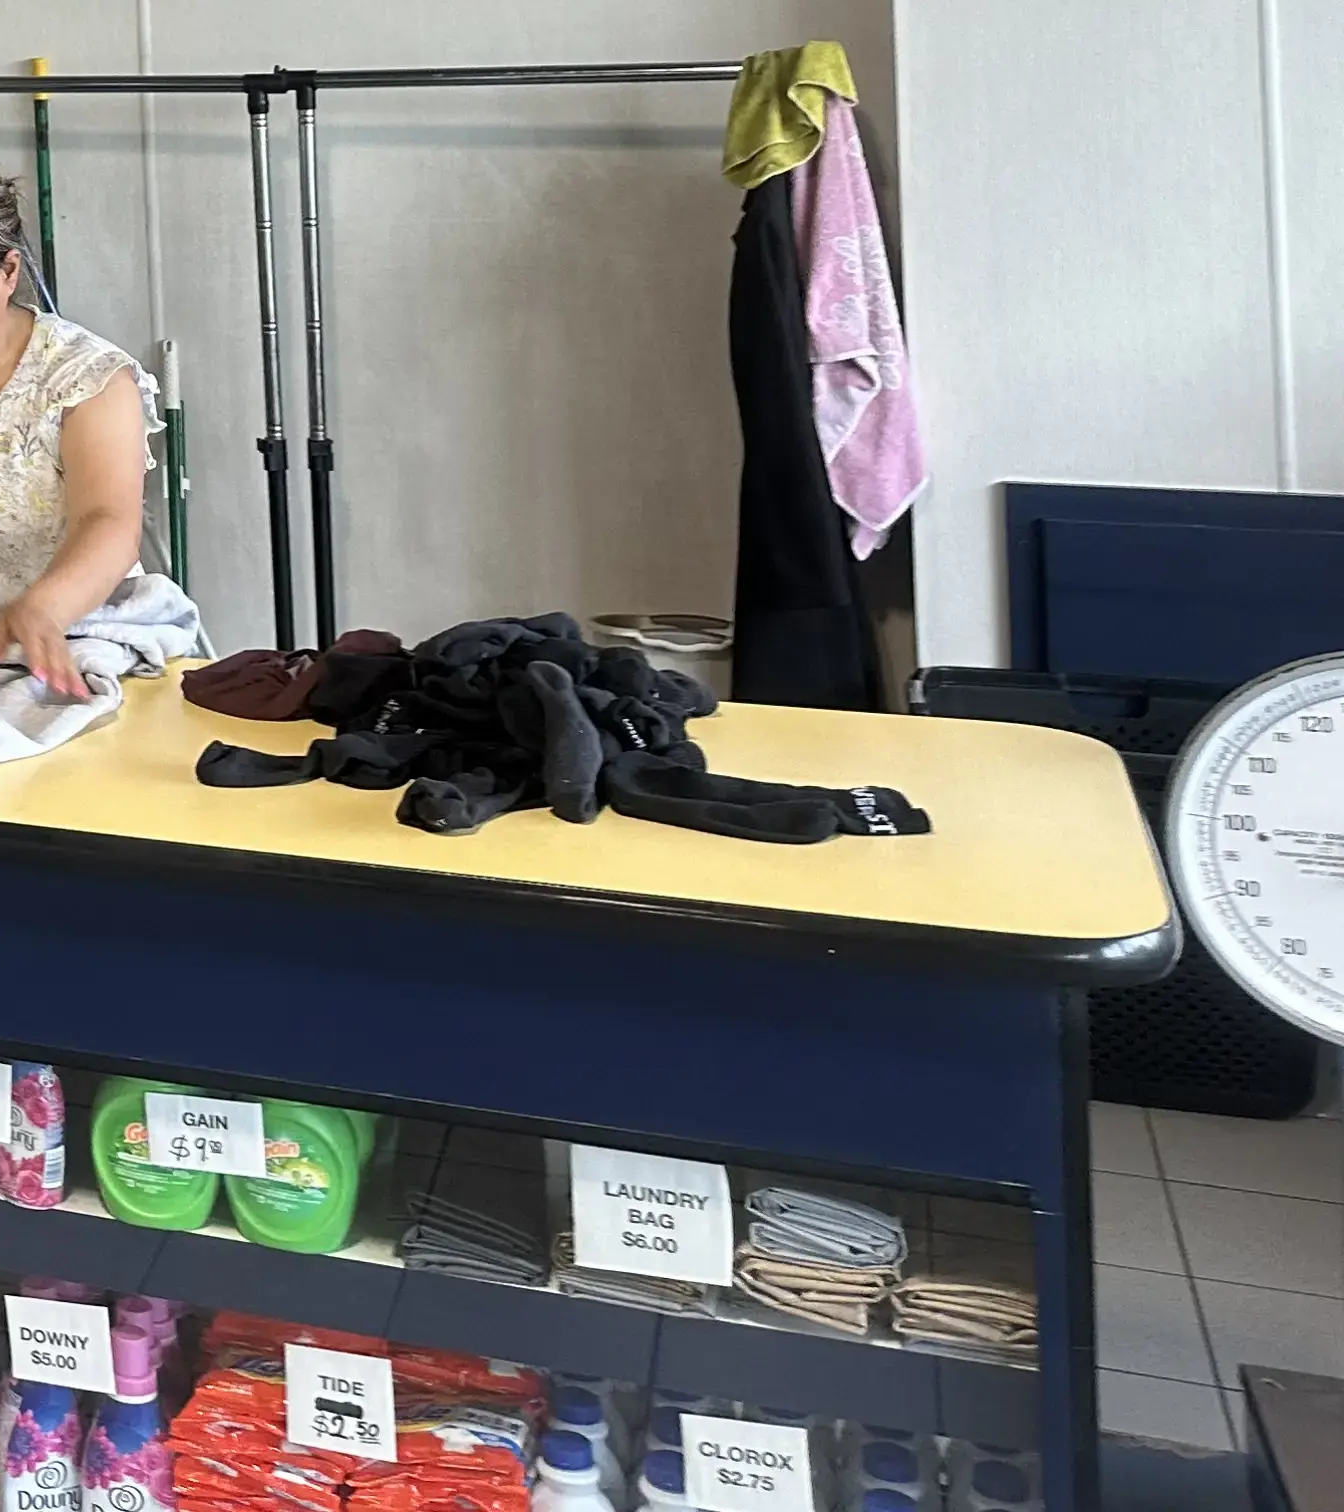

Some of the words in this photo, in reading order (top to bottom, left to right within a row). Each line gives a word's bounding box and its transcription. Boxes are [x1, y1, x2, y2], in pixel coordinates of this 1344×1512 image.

[182, 1112, 229, 1131] GAIN
[265, 1140, 300, 1158] ain
[602, 1180, 711, 1212] LAUNDRY
[627, 1206, 675, 1231] BAG
[620, 1229, 679, 1256] $6.00
[20, 1326, 90, 1351] DOWNY
[30, 1350, 77, 1370] $5.00
[317, 1374, 366, 1398] TIDE
[698, 1441, 795, 1472] CLOROX
[717, 1467, 776, 1493] $2.75
[18, 1488, 82, 1511] Downy
